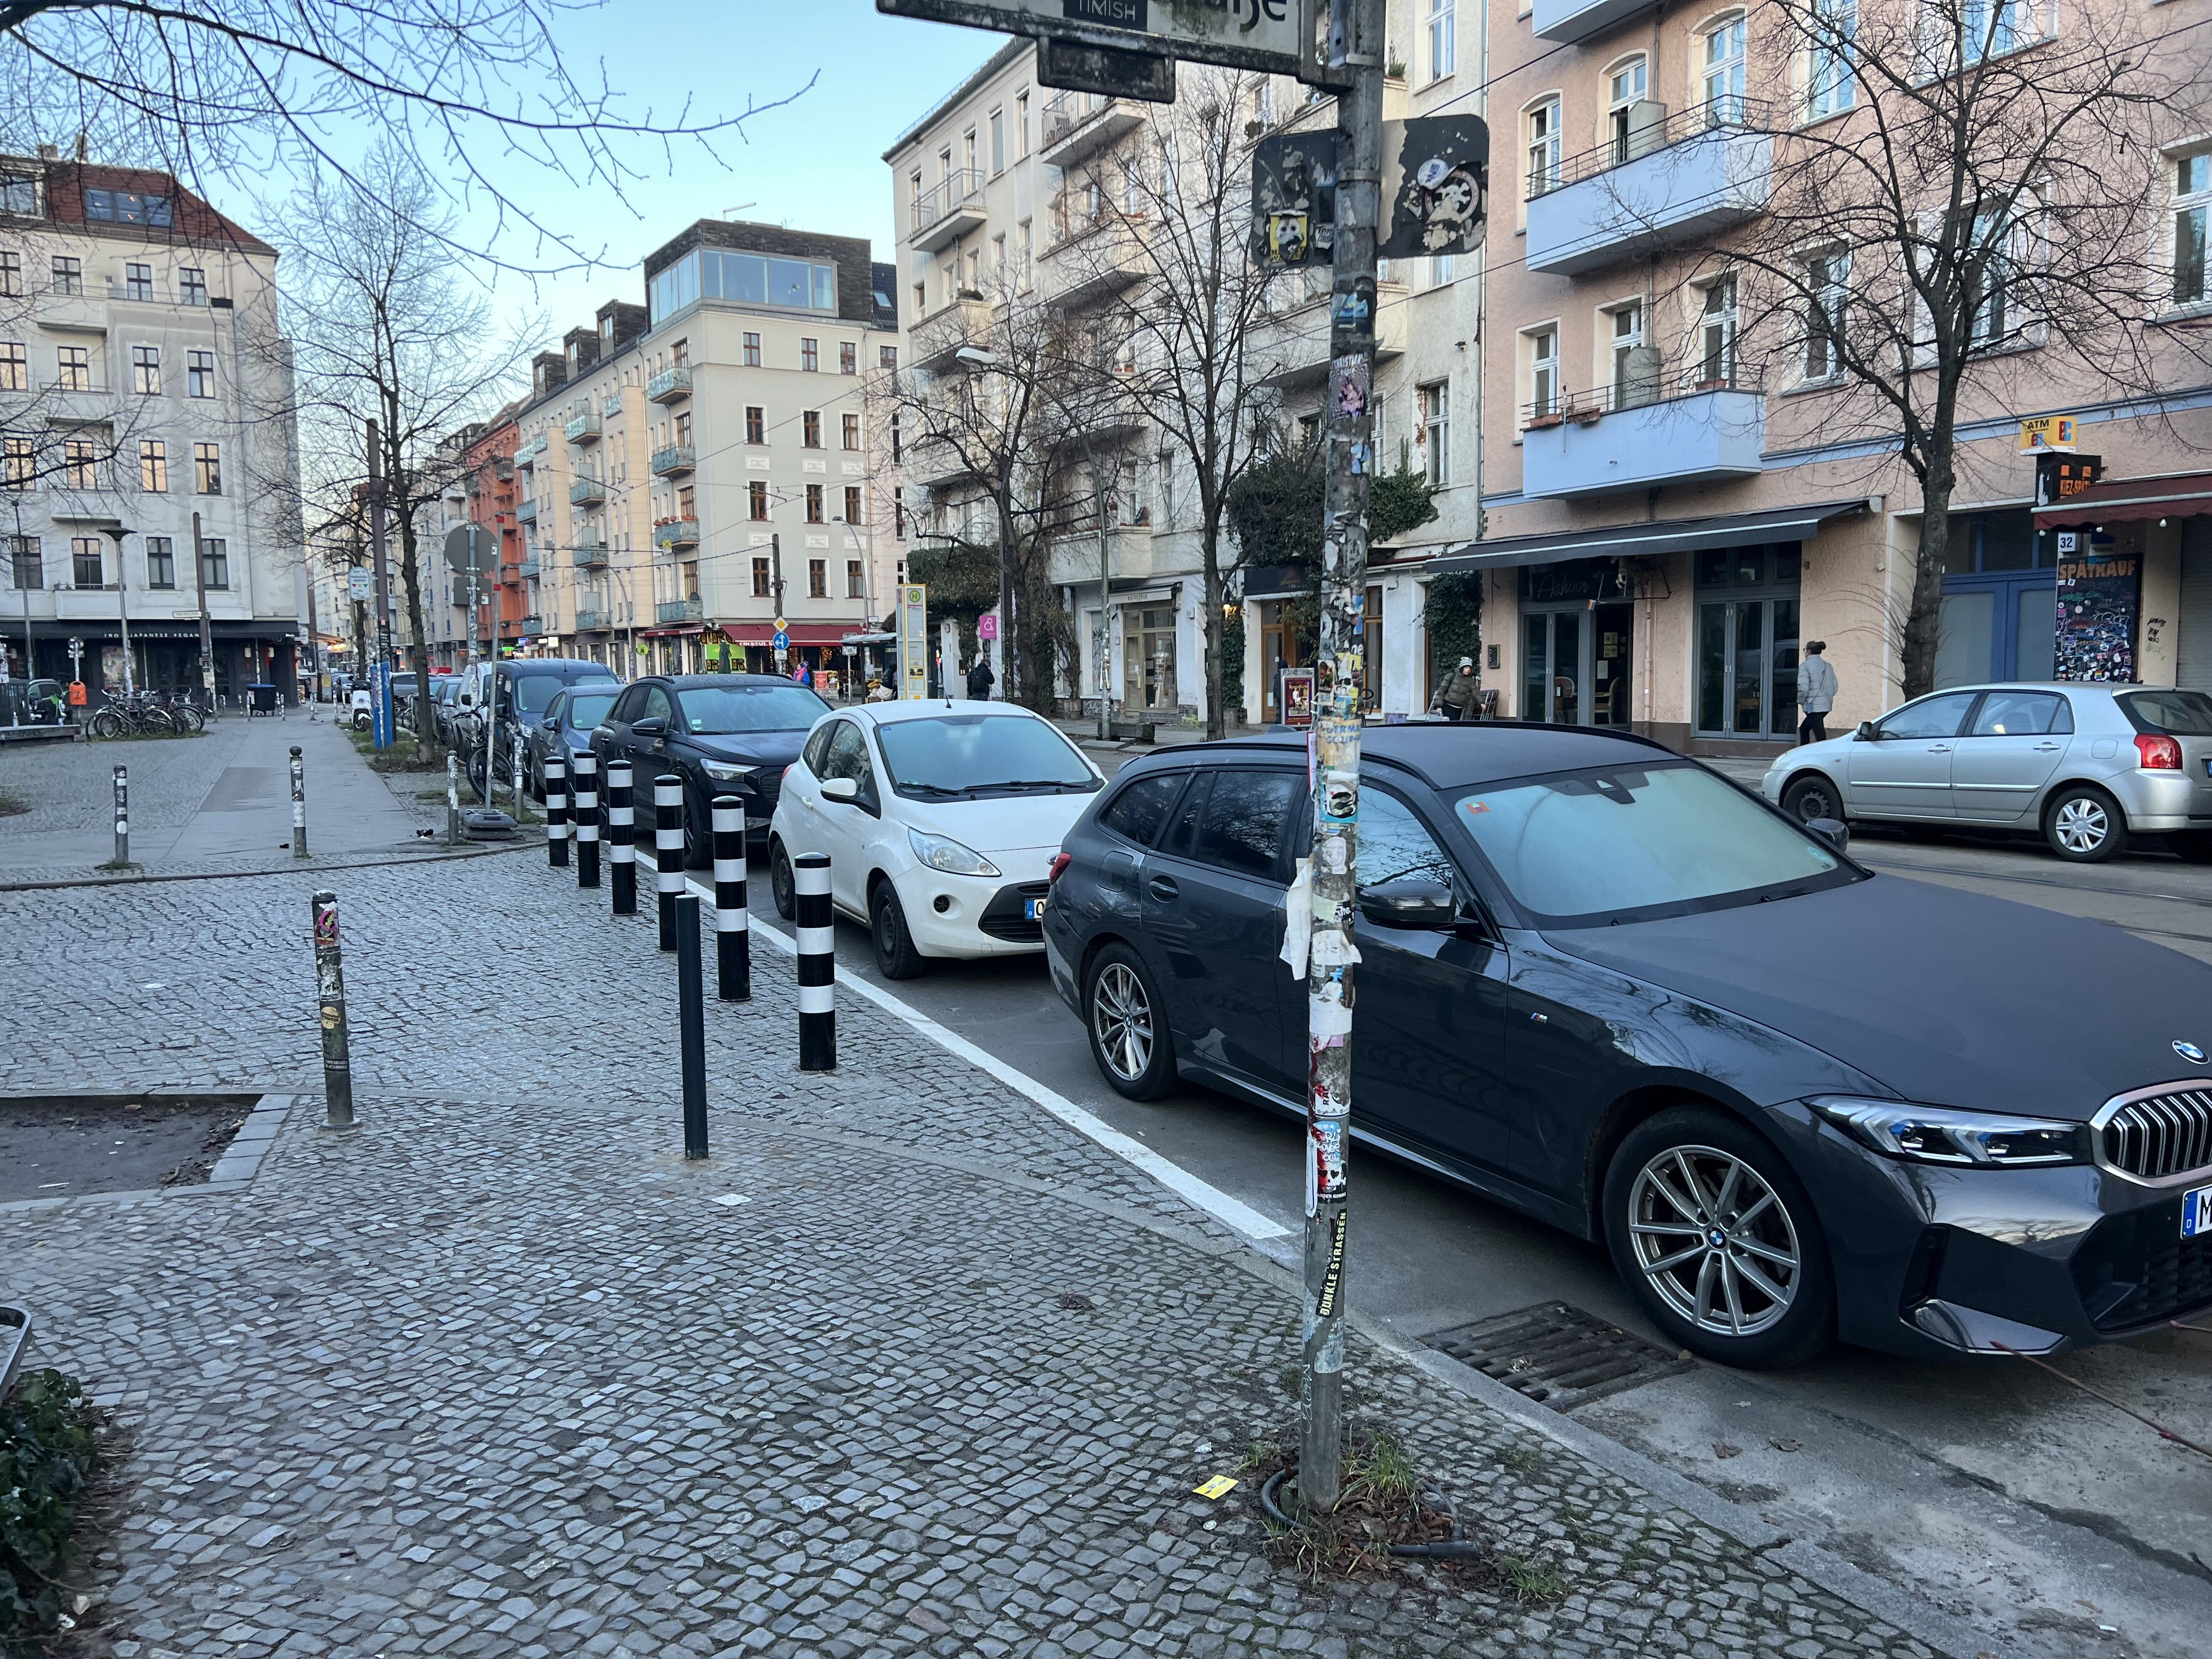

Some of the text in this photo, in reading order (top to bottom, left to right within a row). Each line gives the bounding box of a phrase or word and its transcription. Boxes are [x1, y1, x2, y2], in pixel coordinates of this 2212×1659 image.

[2027, 419, 2050, 430] ATM
[2060, 537, 2073, 548] 32
[2059, 560, 2136, 579] SPÄTKAUF
[706, 658, 746, 671] BR
[2186, 1218, 2192, 1229] D
[1319, 1212, 1346, 1316] DUNKLE STRASSEN
